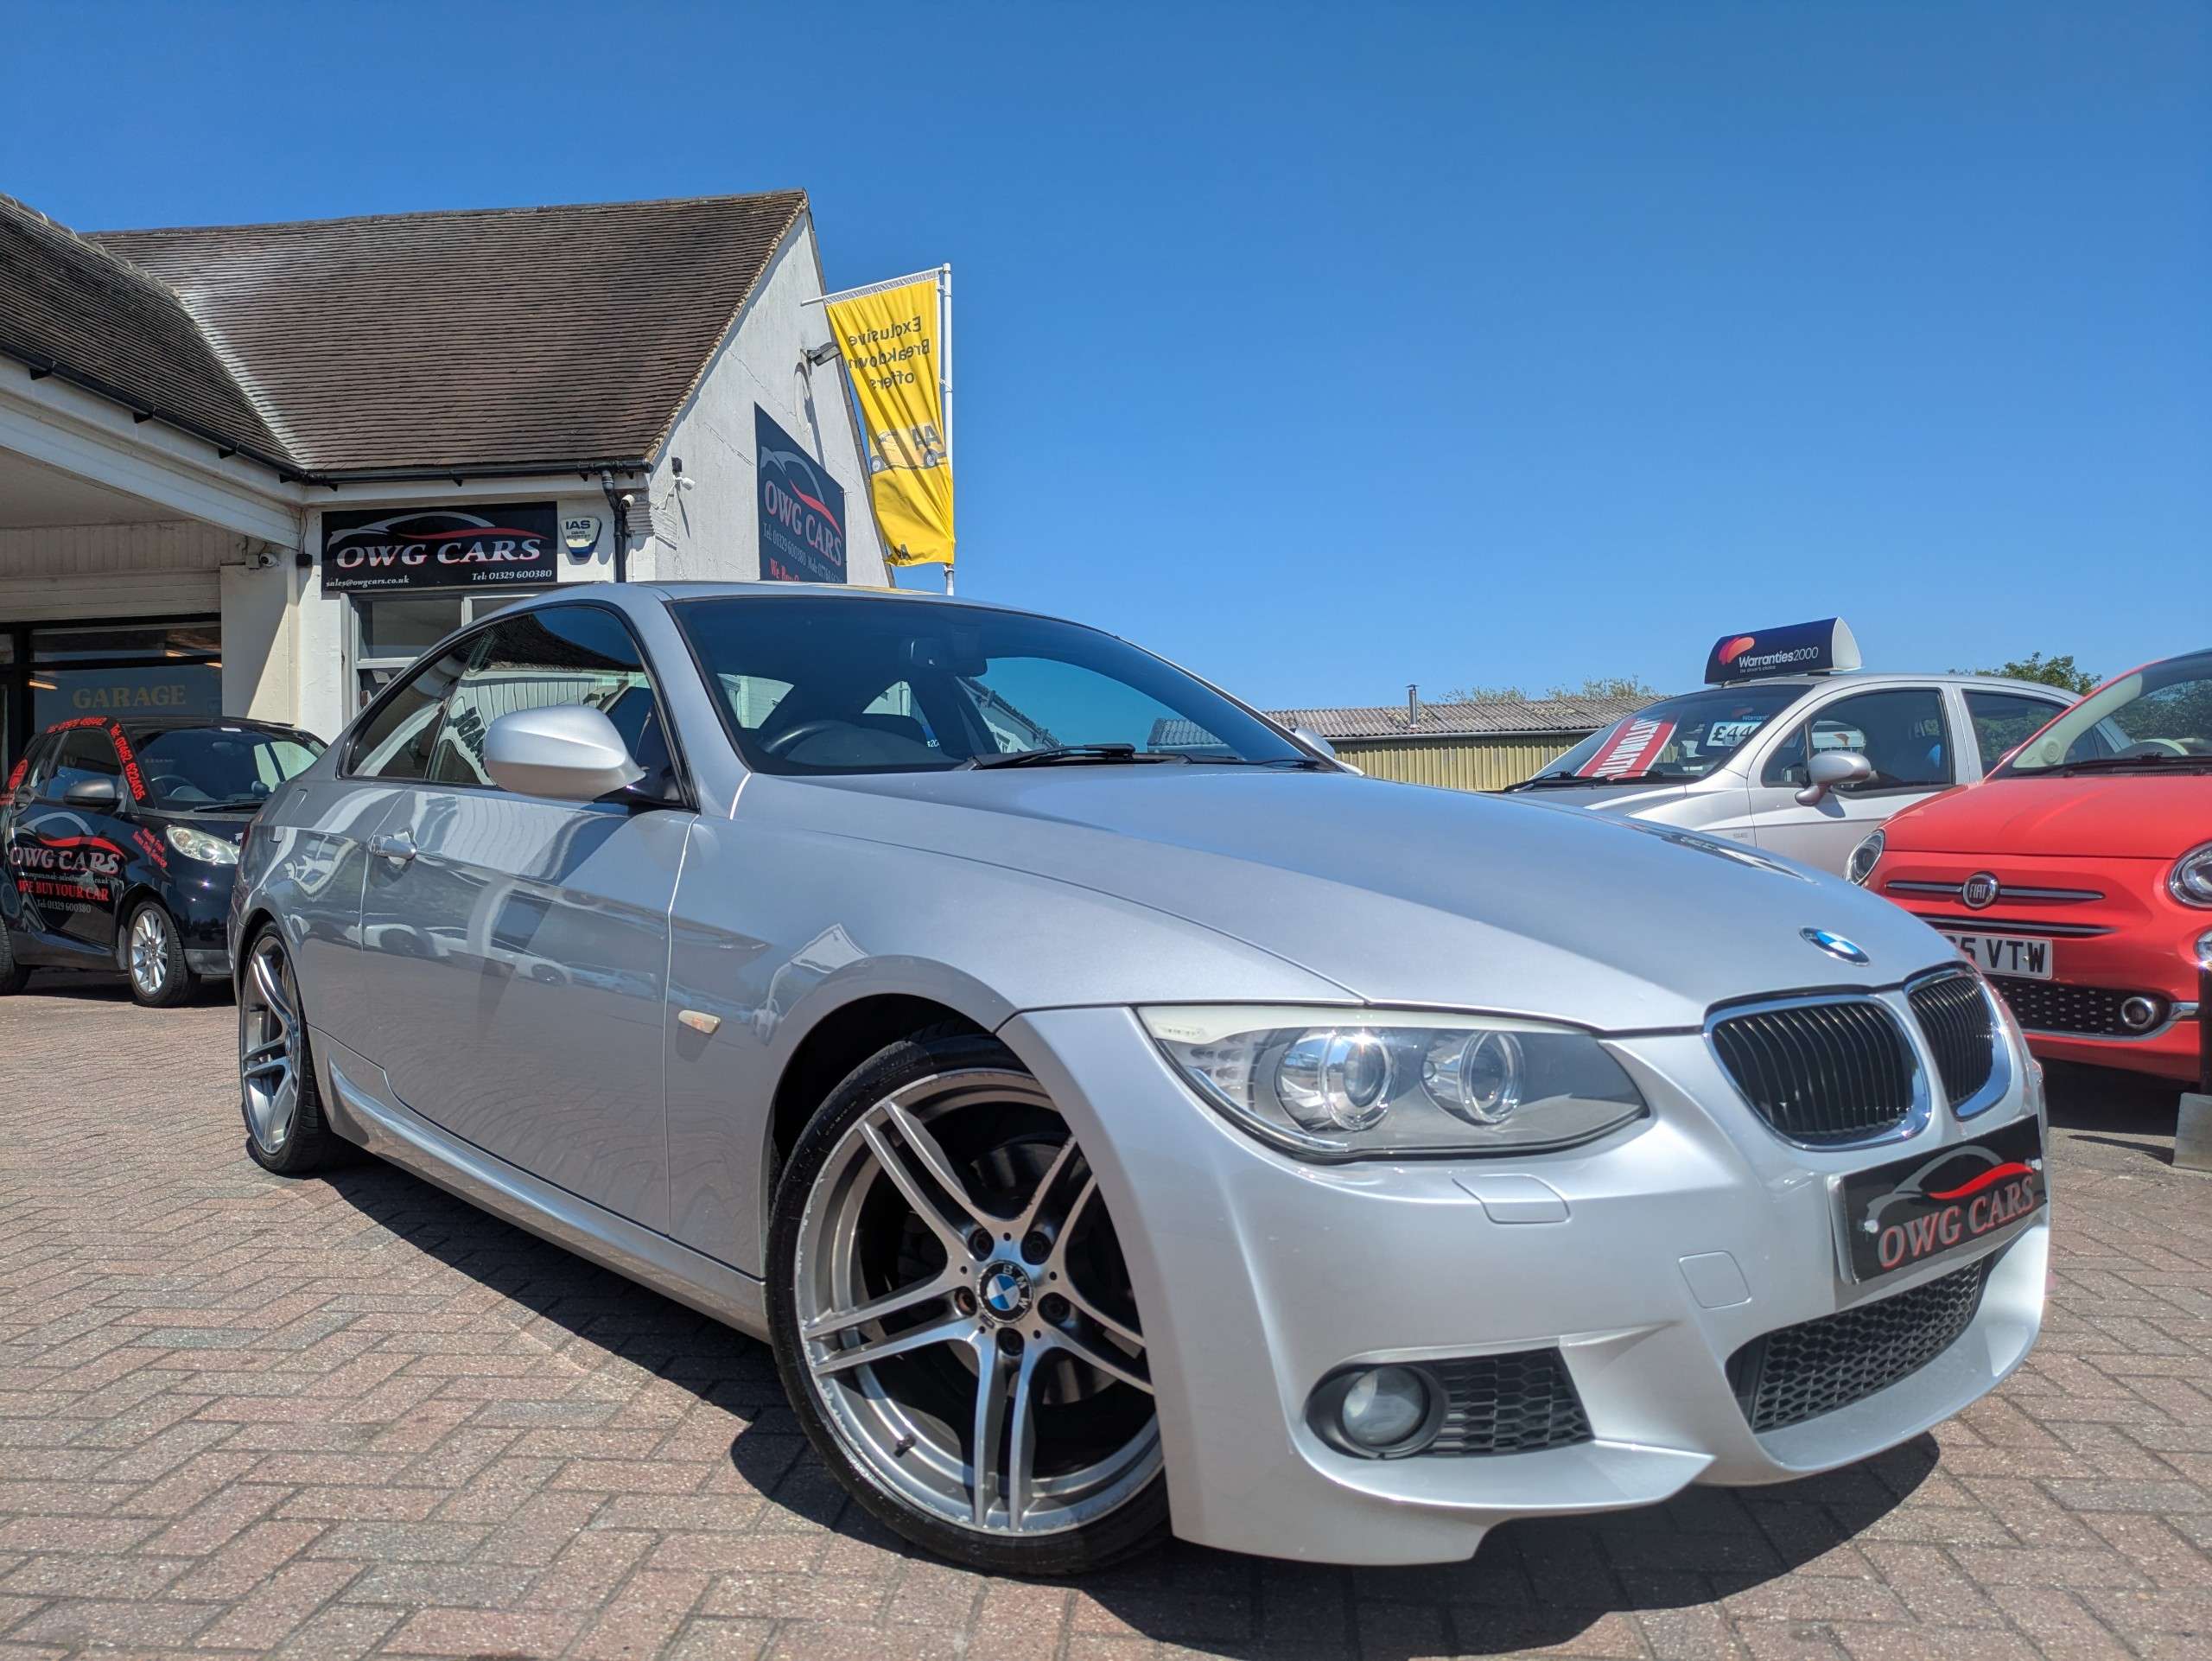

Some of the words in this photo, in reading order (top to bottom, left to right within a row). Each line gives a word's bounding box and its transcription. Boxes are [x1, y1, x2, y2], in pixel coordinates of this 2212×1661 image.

[566, 520, 591, 530] IAS
[765, 480, 802, 535] OWG
[805, 514, 842, 567] CARS
[336, 544, 429, 569] OWG
[435, 538, 542, 564] CARS
[326, 576, 410, 589] sales@owgcars.co.uk
[472, 572, 487, 581] Tel:
[488, 570, 515, 581] 01329
[516, 569, 553, 579] 600380
[1738, 646, 1819, 669] Warranties2000
[73, 684, 187, 709] GARAGE
[10, 847, 54, 869] OWG
[58, 850, 120, 875] CARS
[18, 879, 35, 893] WE
[35, 881, 55, 895] BUY
[55, 883, 84, 899] YOUR
[85, 887, 110, 901] CAR
[1969, 884, 1987, 899] FIAT
[47, 900, 65, 910] 01329
[65, 902, 92, 913] 600380
[1986, 939, 2045, 973] VTW
[1878, 1205, 1962, 1270] OWG
[1968, 1175, 2035, 1235] CARS
[1002, 1264, 1029, 1309] BMW
